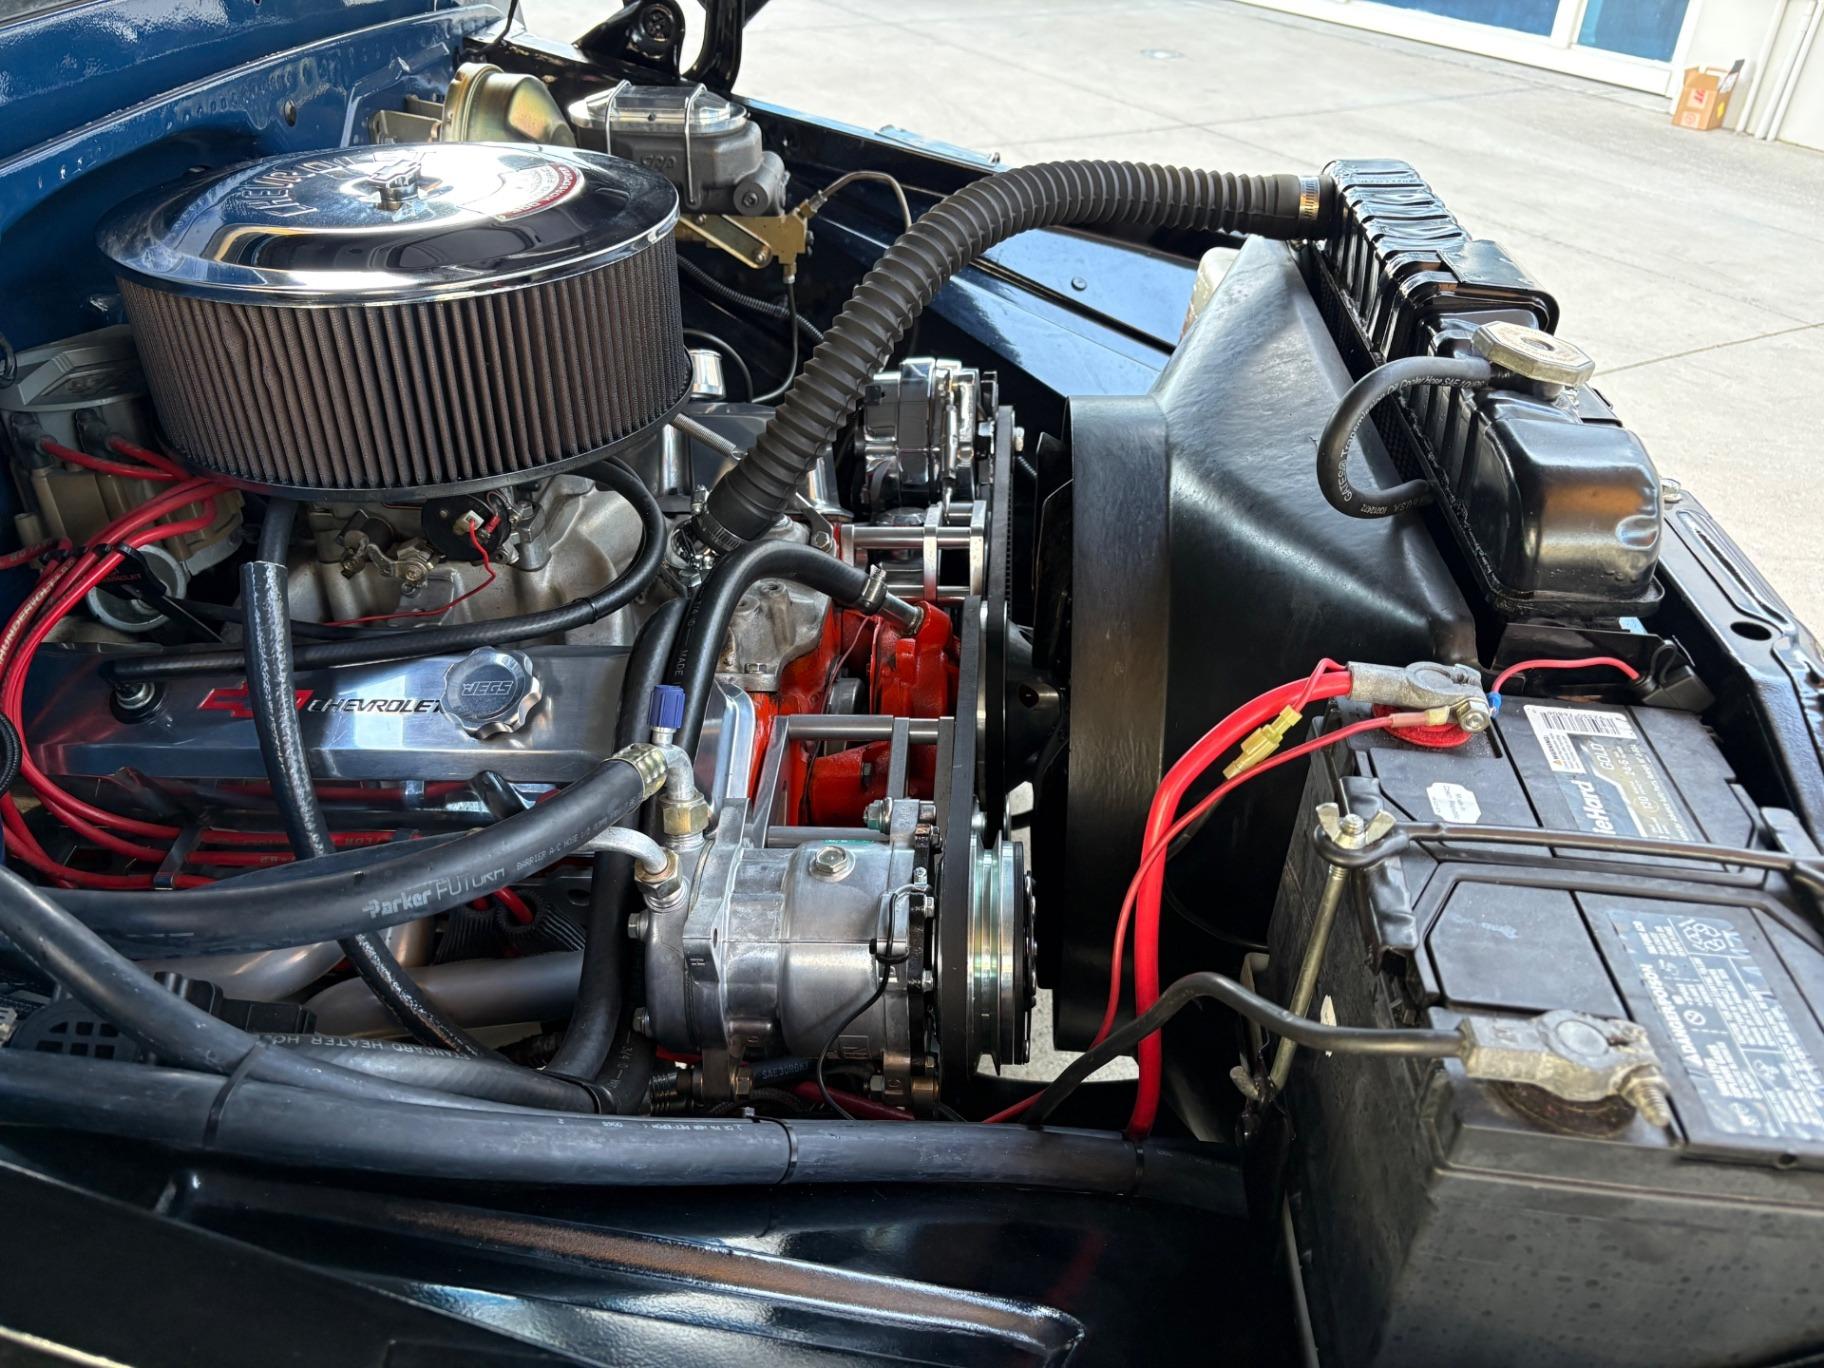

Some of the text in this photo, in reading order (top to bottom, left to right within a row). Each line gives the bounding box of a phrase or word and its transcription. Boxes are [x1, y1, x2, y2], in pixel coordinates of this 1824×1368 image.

[674, 650, 688, 676] MADE
[462, 681, 513, 696] JEGS
[309, 700, 444, 712] CHEVROLET
[1591, 743, 1614, 770] GOLD
[1571, 778, 1616, 834] ieHard
[362, 889, 432, 919] Parker
[266, 1033, 300, 1046] HO
[311, 1036, 383, 1050] HEATER
